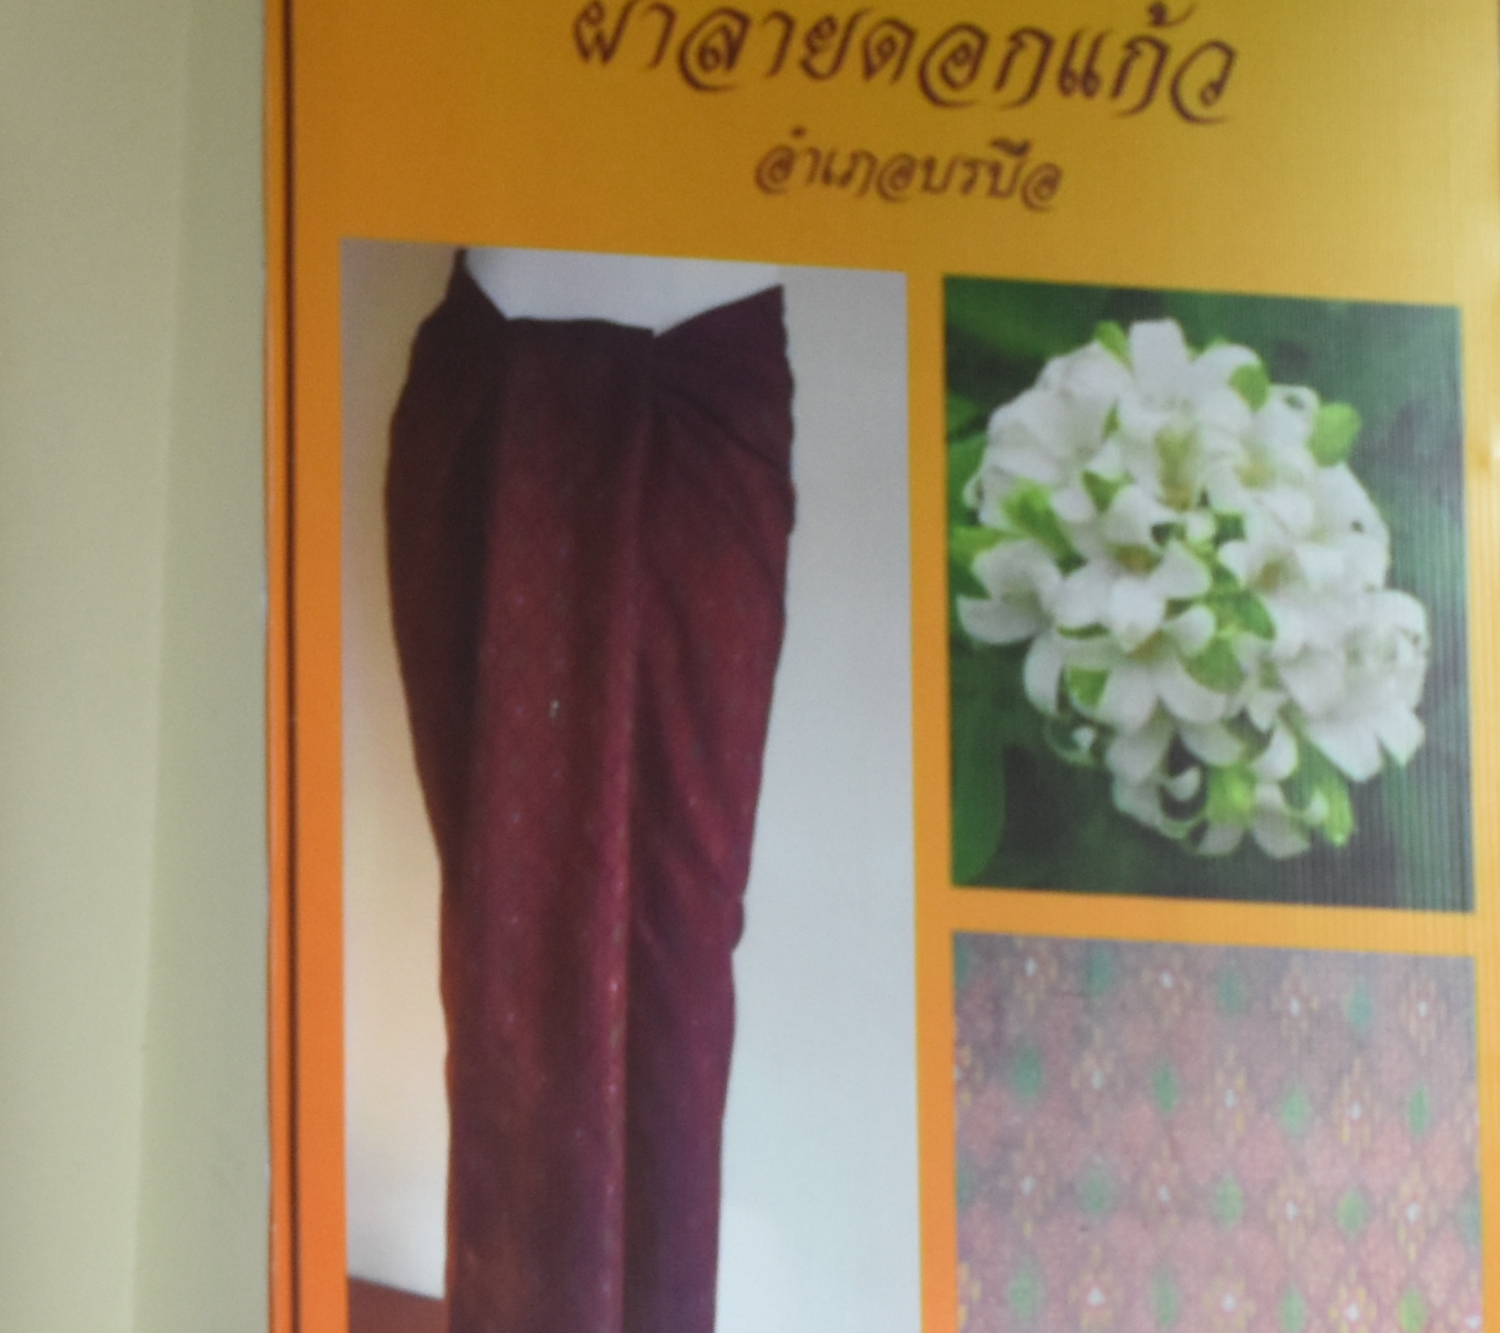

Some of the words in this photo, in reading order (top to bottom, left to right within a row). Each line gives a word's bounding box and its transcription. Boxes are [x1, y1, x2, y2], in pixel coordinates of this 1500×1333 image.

[573, 0, 1237, 125] ผาลายดอกแก้ว
[754, 126, 1063, 212] อำเภอบรบือ
